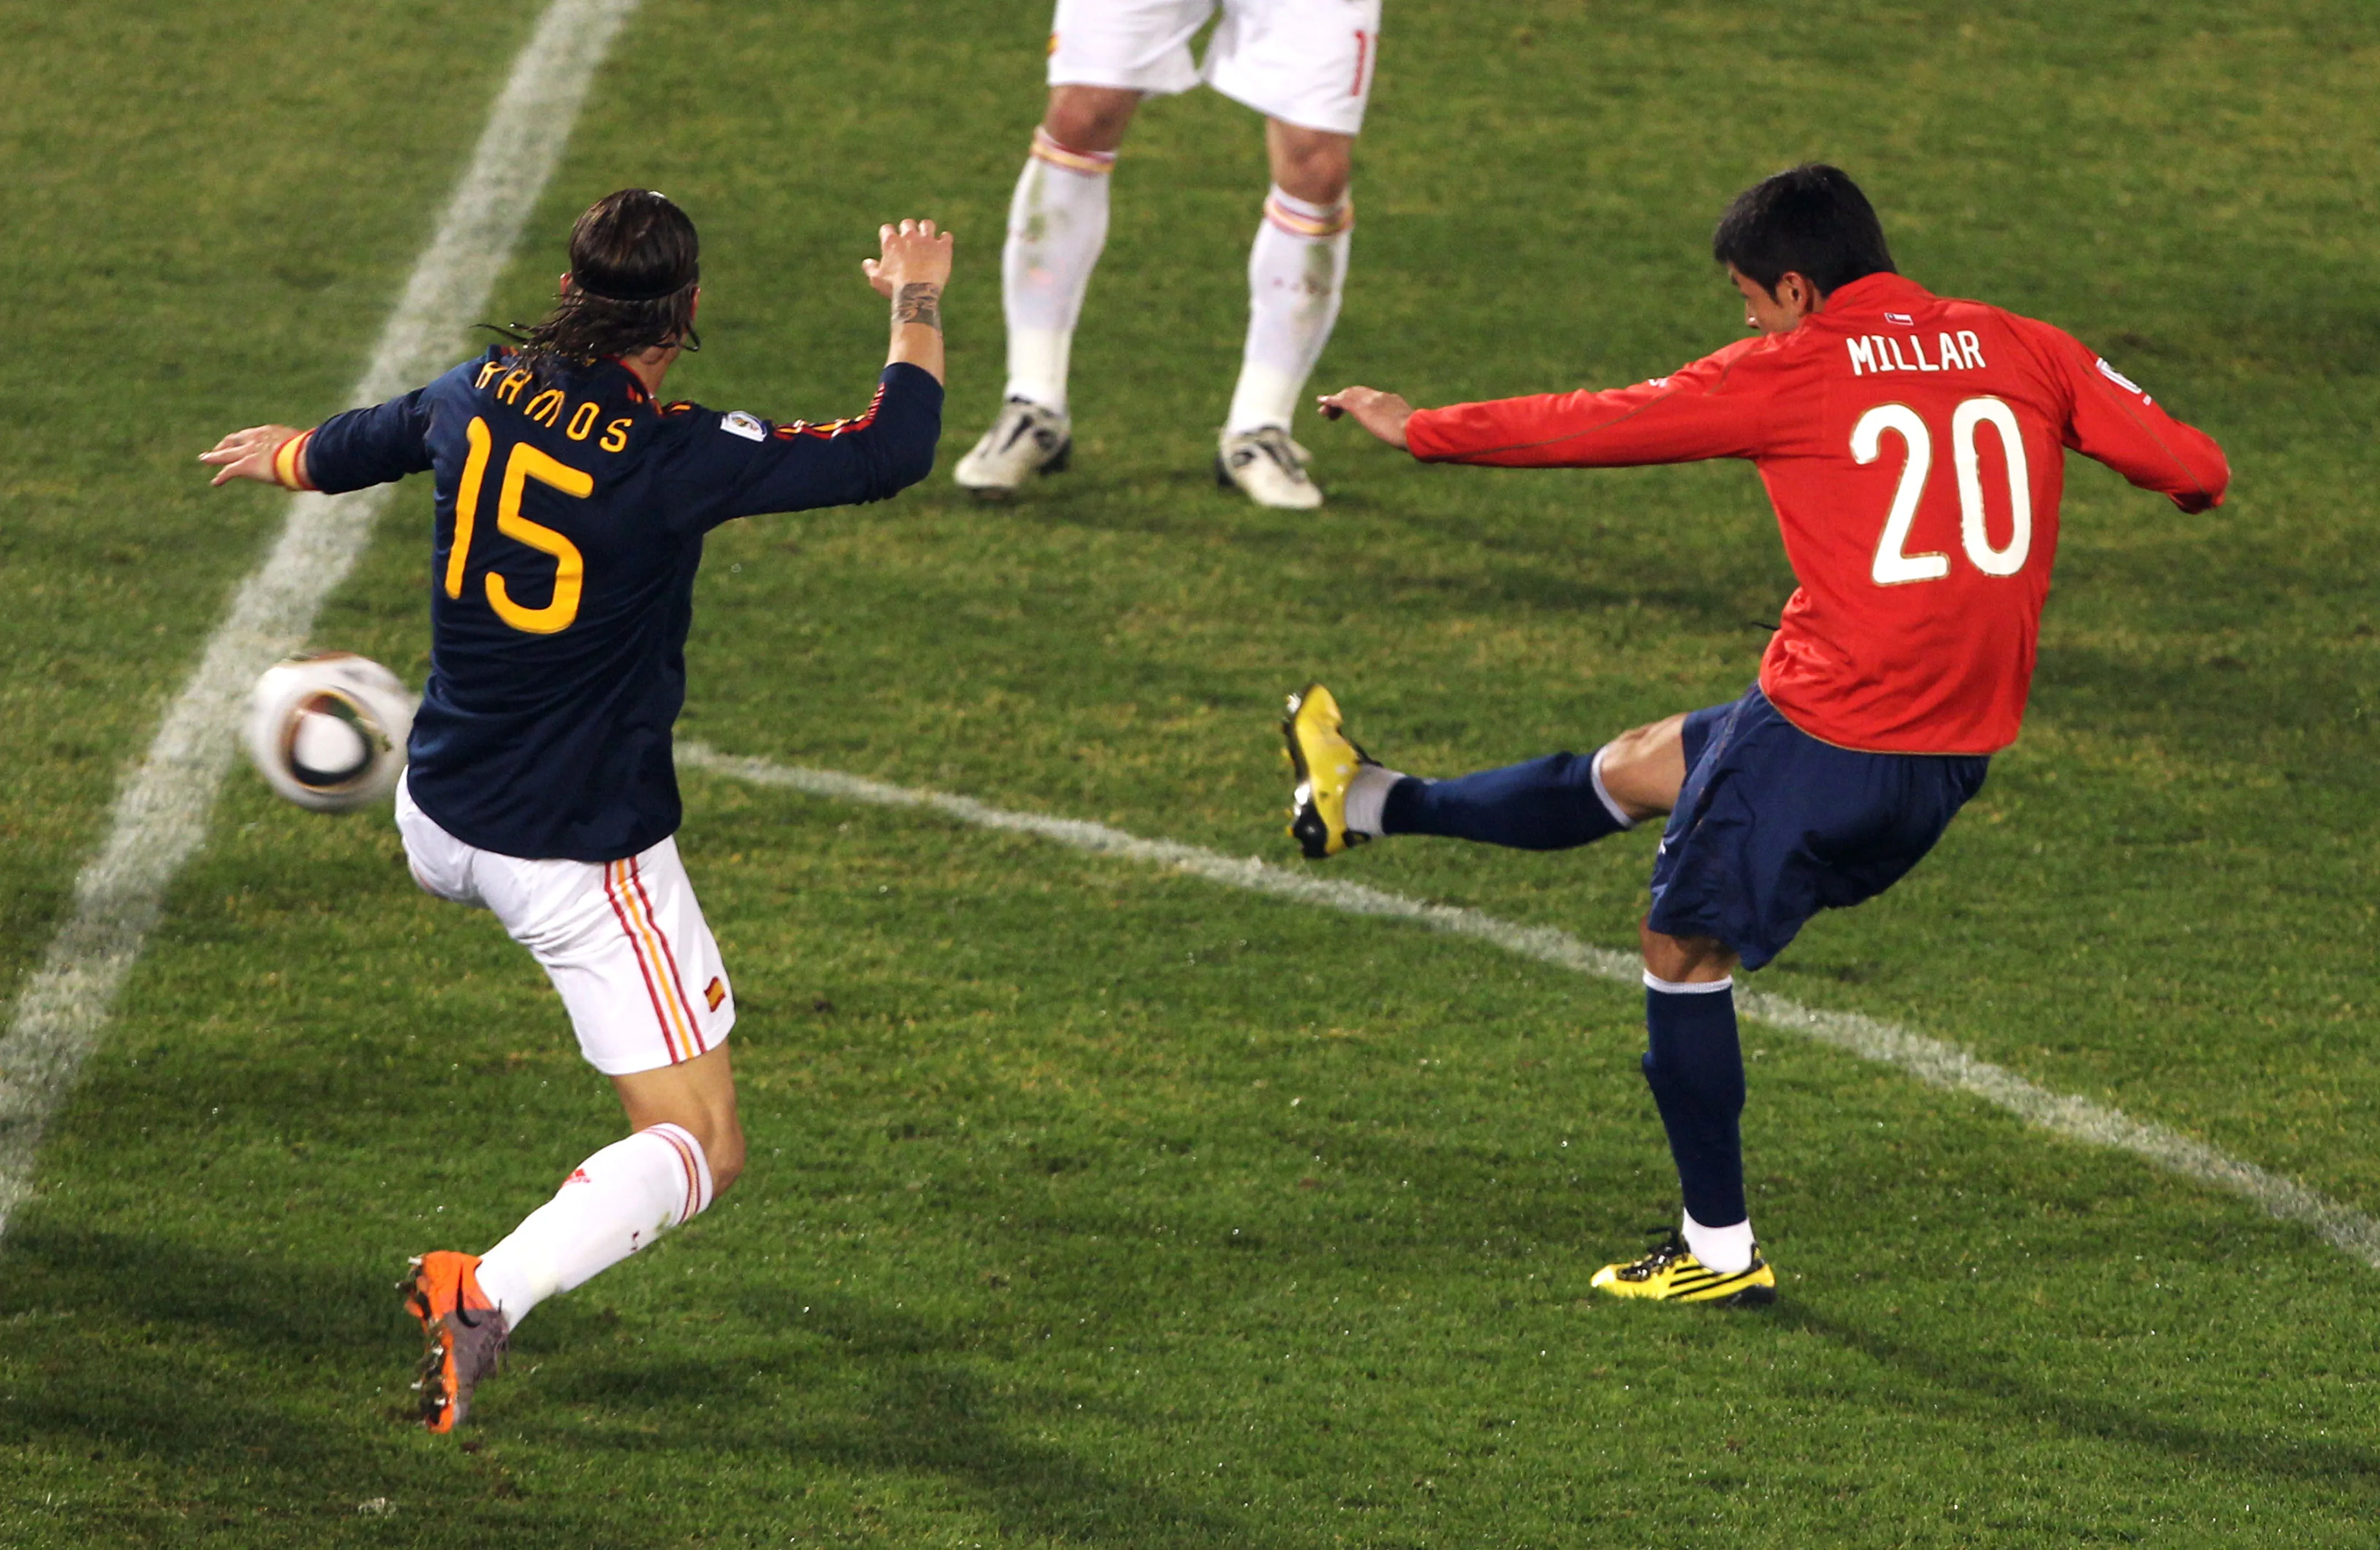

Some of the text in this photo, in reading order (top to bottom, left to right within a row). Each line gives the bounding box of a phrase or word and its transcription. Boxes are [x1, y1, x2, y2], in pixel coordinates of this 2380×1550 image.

[475, 361, 632, 452] RAMOS
[1846, 330, 1986, 376] MILLAR
[444, 415, 593, 633] 15
[1849, 395, 2031, 586] 20
